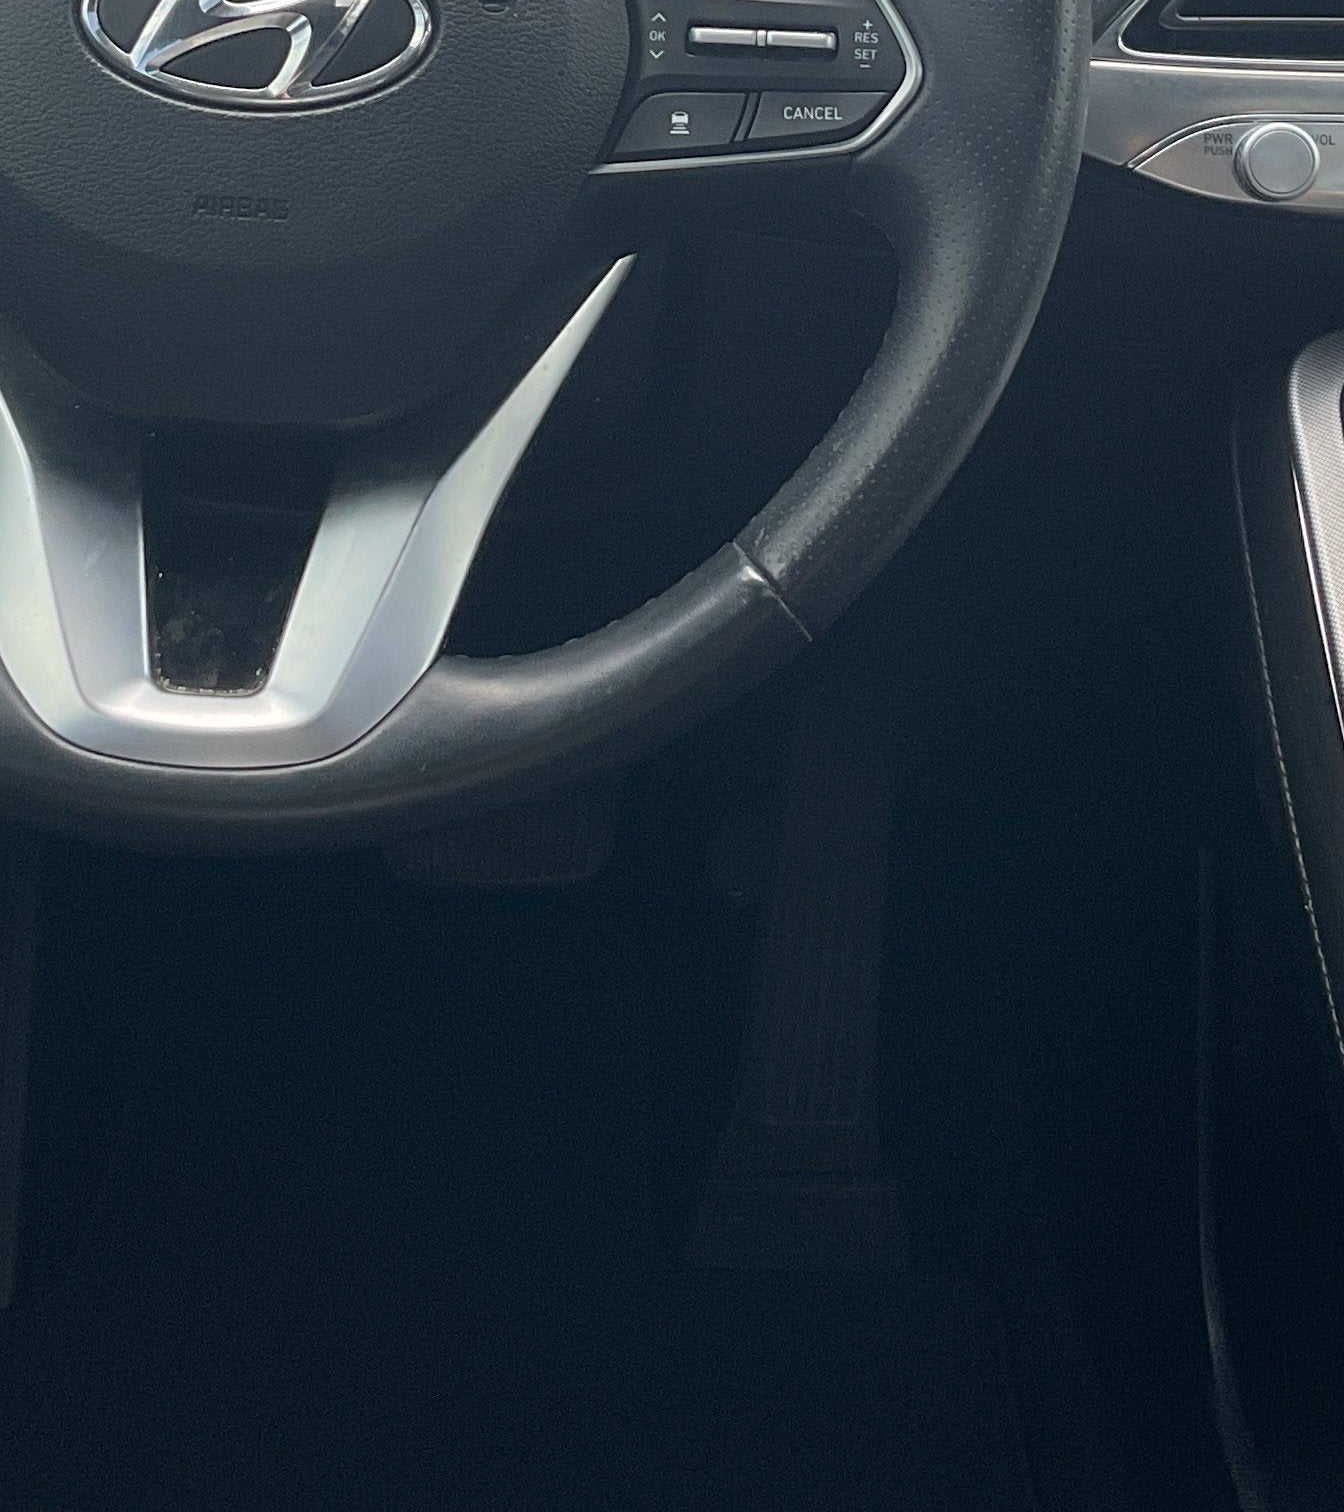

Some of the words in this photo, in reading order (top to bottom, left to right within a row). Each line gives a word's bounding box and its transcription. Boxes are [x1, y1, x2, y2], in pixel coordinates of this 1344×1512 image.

[648, 29, 667, 43] OK
[854, 30, 879, 44] RES
[853, 48, 878, 61] SET
[782, 105, 843, 121] CANCEL
[1203, 133, 1234, 145] PWR
[1203, 145, 1234, 156] PUSH
